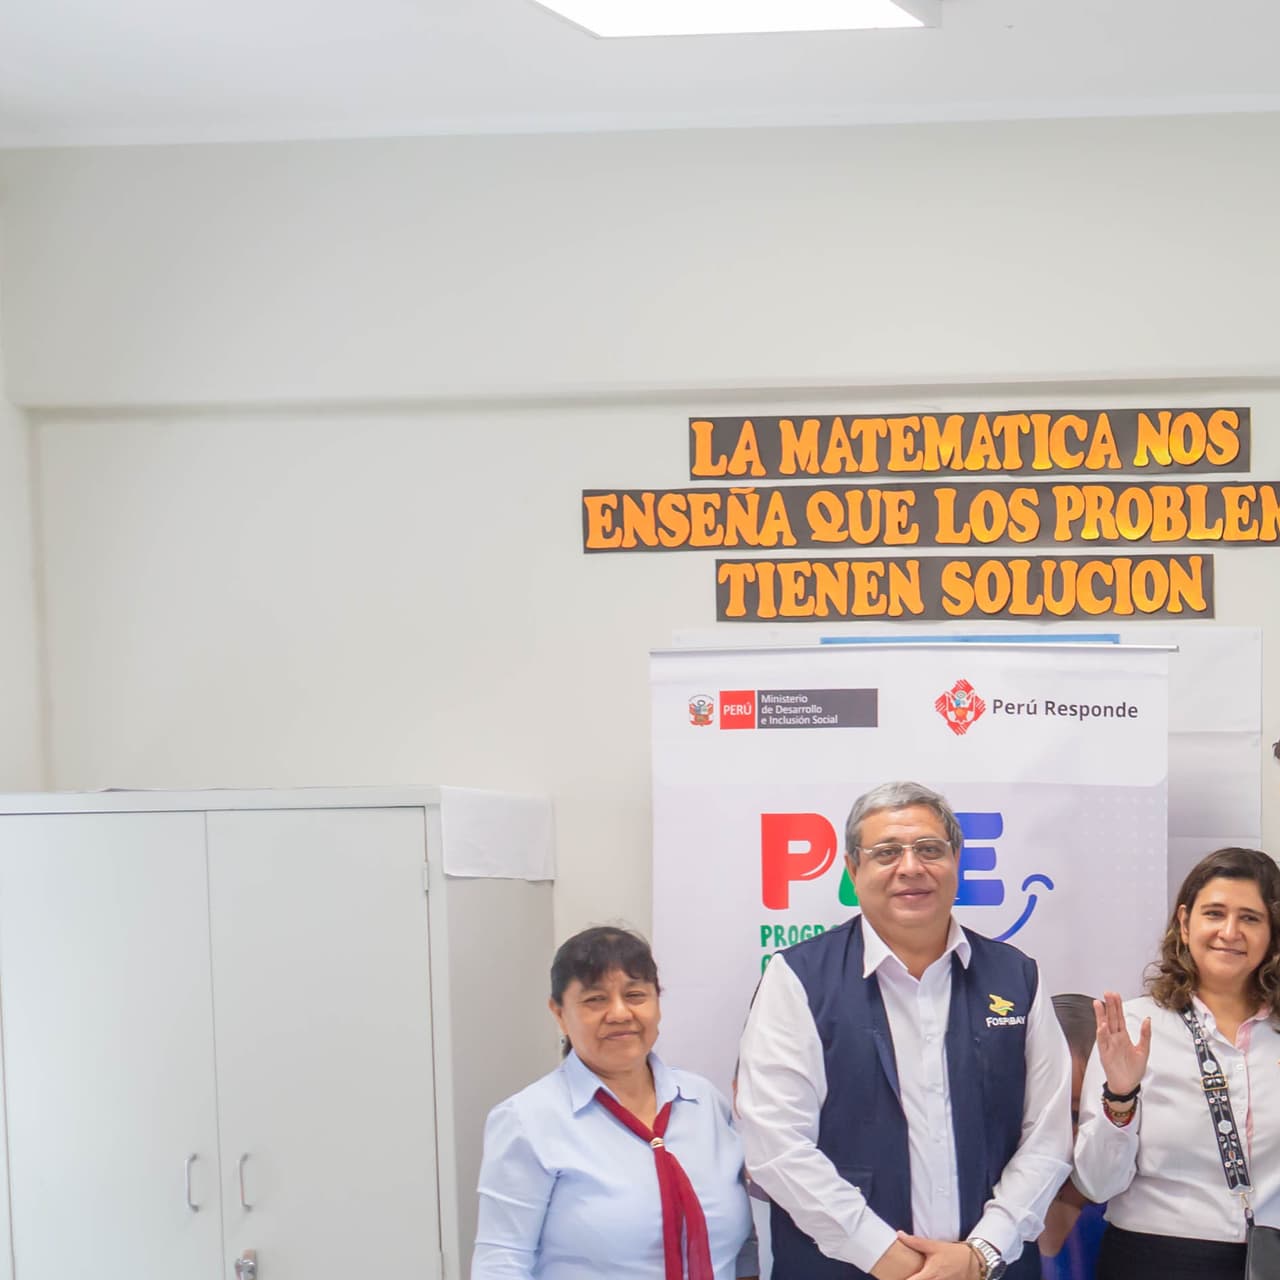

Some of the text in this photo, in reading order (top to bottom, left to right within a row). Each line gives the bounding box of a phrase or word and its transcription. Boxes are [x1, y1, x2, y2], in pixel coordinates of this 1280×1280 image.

[690, 409, 1240, 477] LA MATEMATICA NOS
[583, 486, 798, 549] ENSEÑA
[805, 488, 920, 546] QUE
[933, 487, 1041, 545] LOS
[717, 555, 1207, 619] TIENEN SOLUCION
[723, 702, 752, 716] PERÚ
[761, 694, 808, 704] Ministerio
[761, 704, 822, 714] de Desarrollo
[993, 699, 1138, 721] Perú Responde
[769, 715, 810, 725] Inclusión
[812, 715, 838, 724] Social
[761, 812, 1004, 910] PE
[760, 924, 840, 947] PROG
